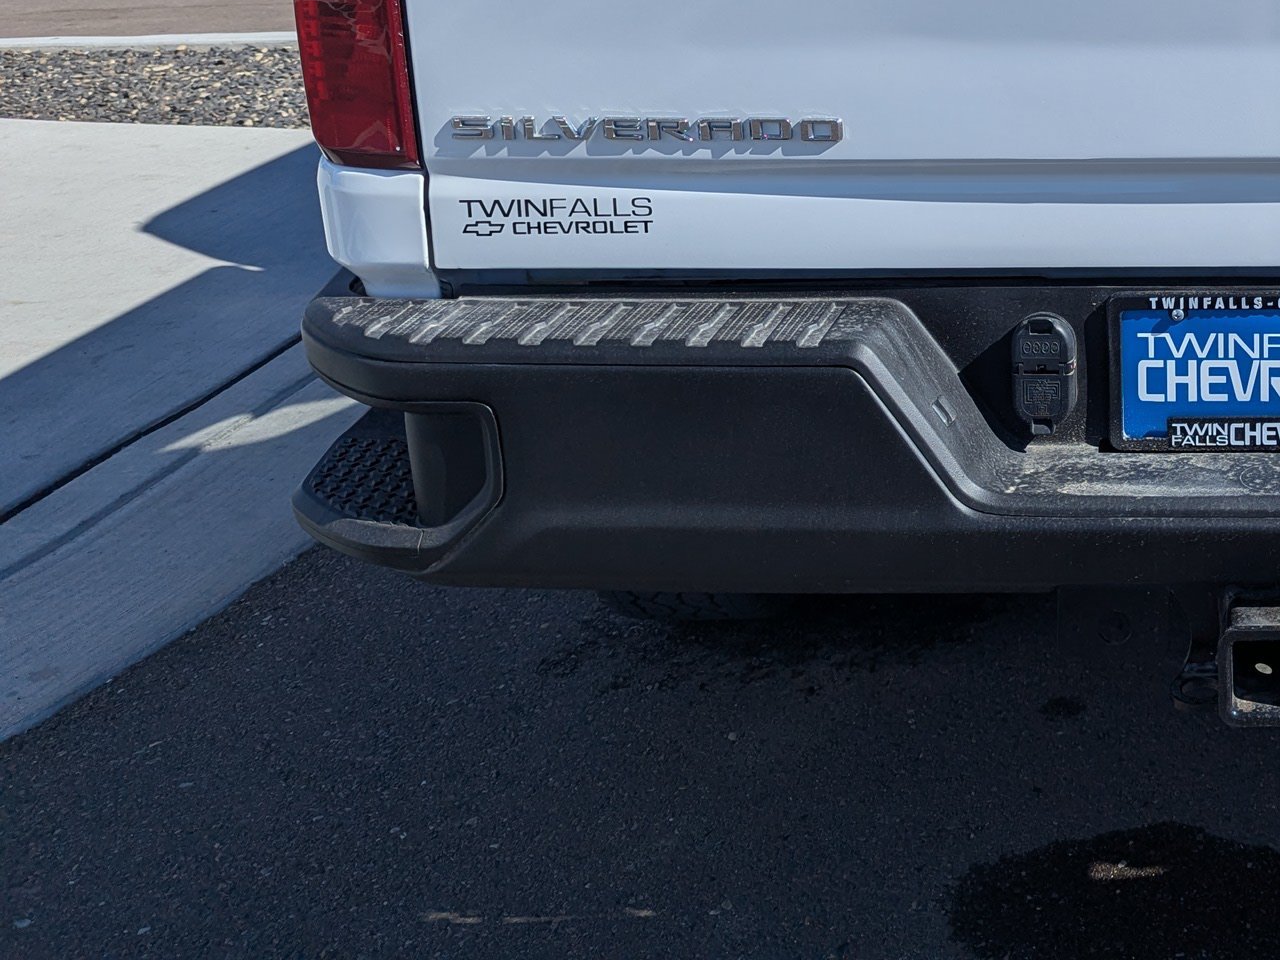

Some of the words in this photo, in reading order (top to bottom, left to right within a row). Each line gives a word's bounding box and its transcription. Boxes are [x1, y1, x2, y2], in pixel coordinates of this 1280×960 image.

[450, 115, 844, 142] SILVERADO
[512, 220, 654, 235] CHEVROLET
[1171, 423, 1228, 436] TWIN
[1171, 435, 1229, 446] FALLS
